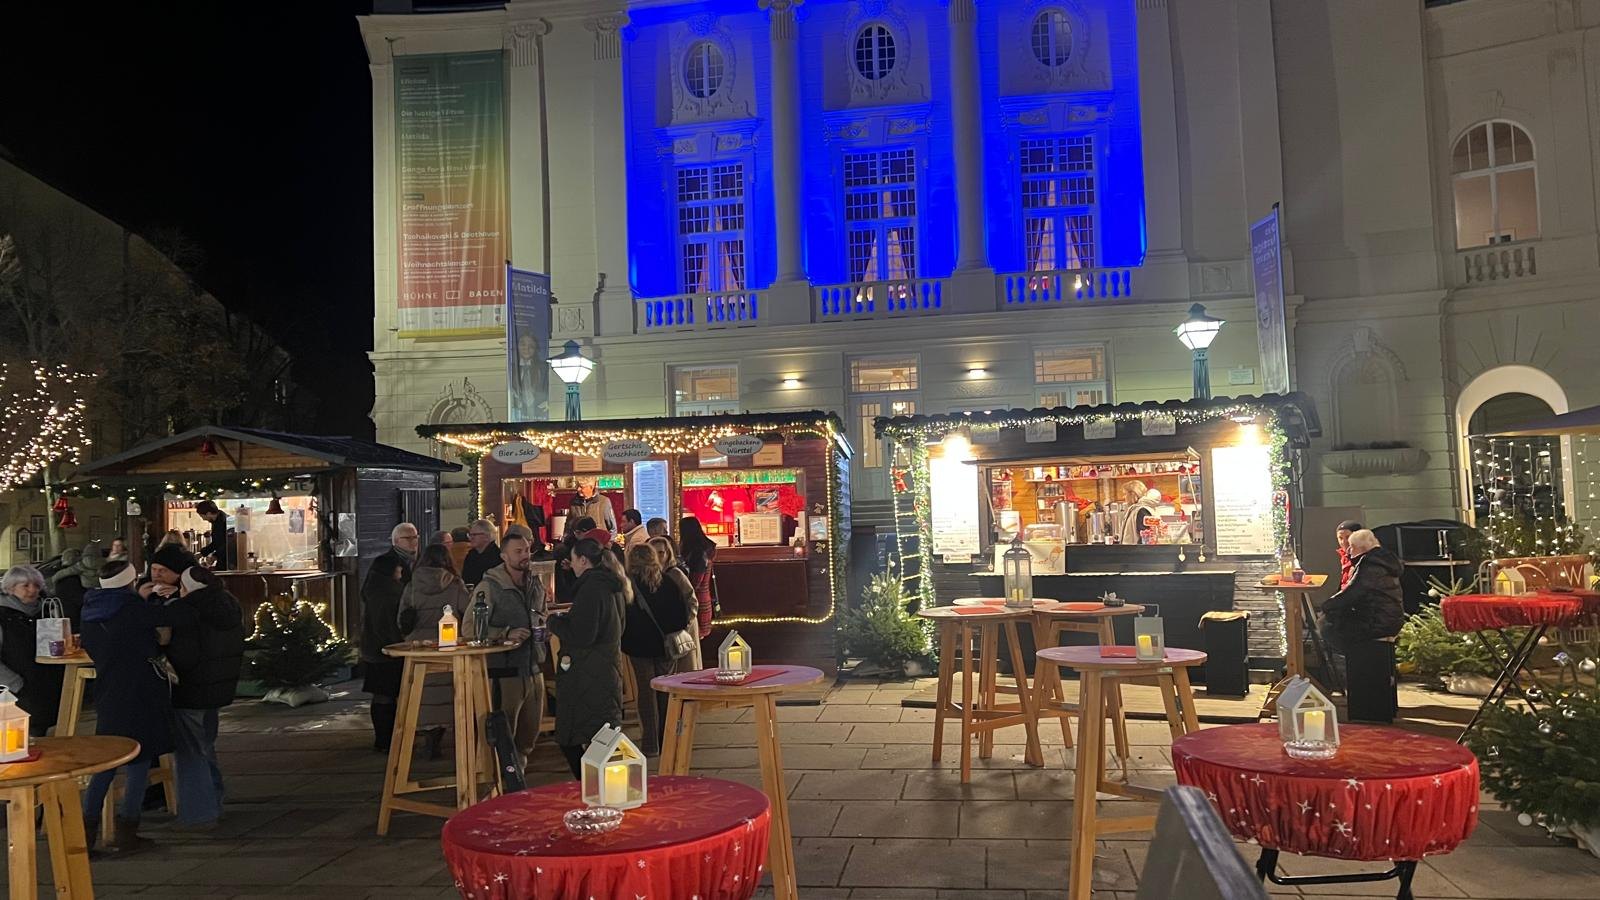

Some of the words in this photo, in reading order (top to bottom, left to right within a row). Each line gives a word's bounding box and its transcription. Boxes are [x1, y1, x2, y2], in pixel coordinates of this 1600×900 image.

[469, 289, 503, 298] BADEN
[498, 449, 514, 457] Bier
[519, 448, 535, 456] Sekt
